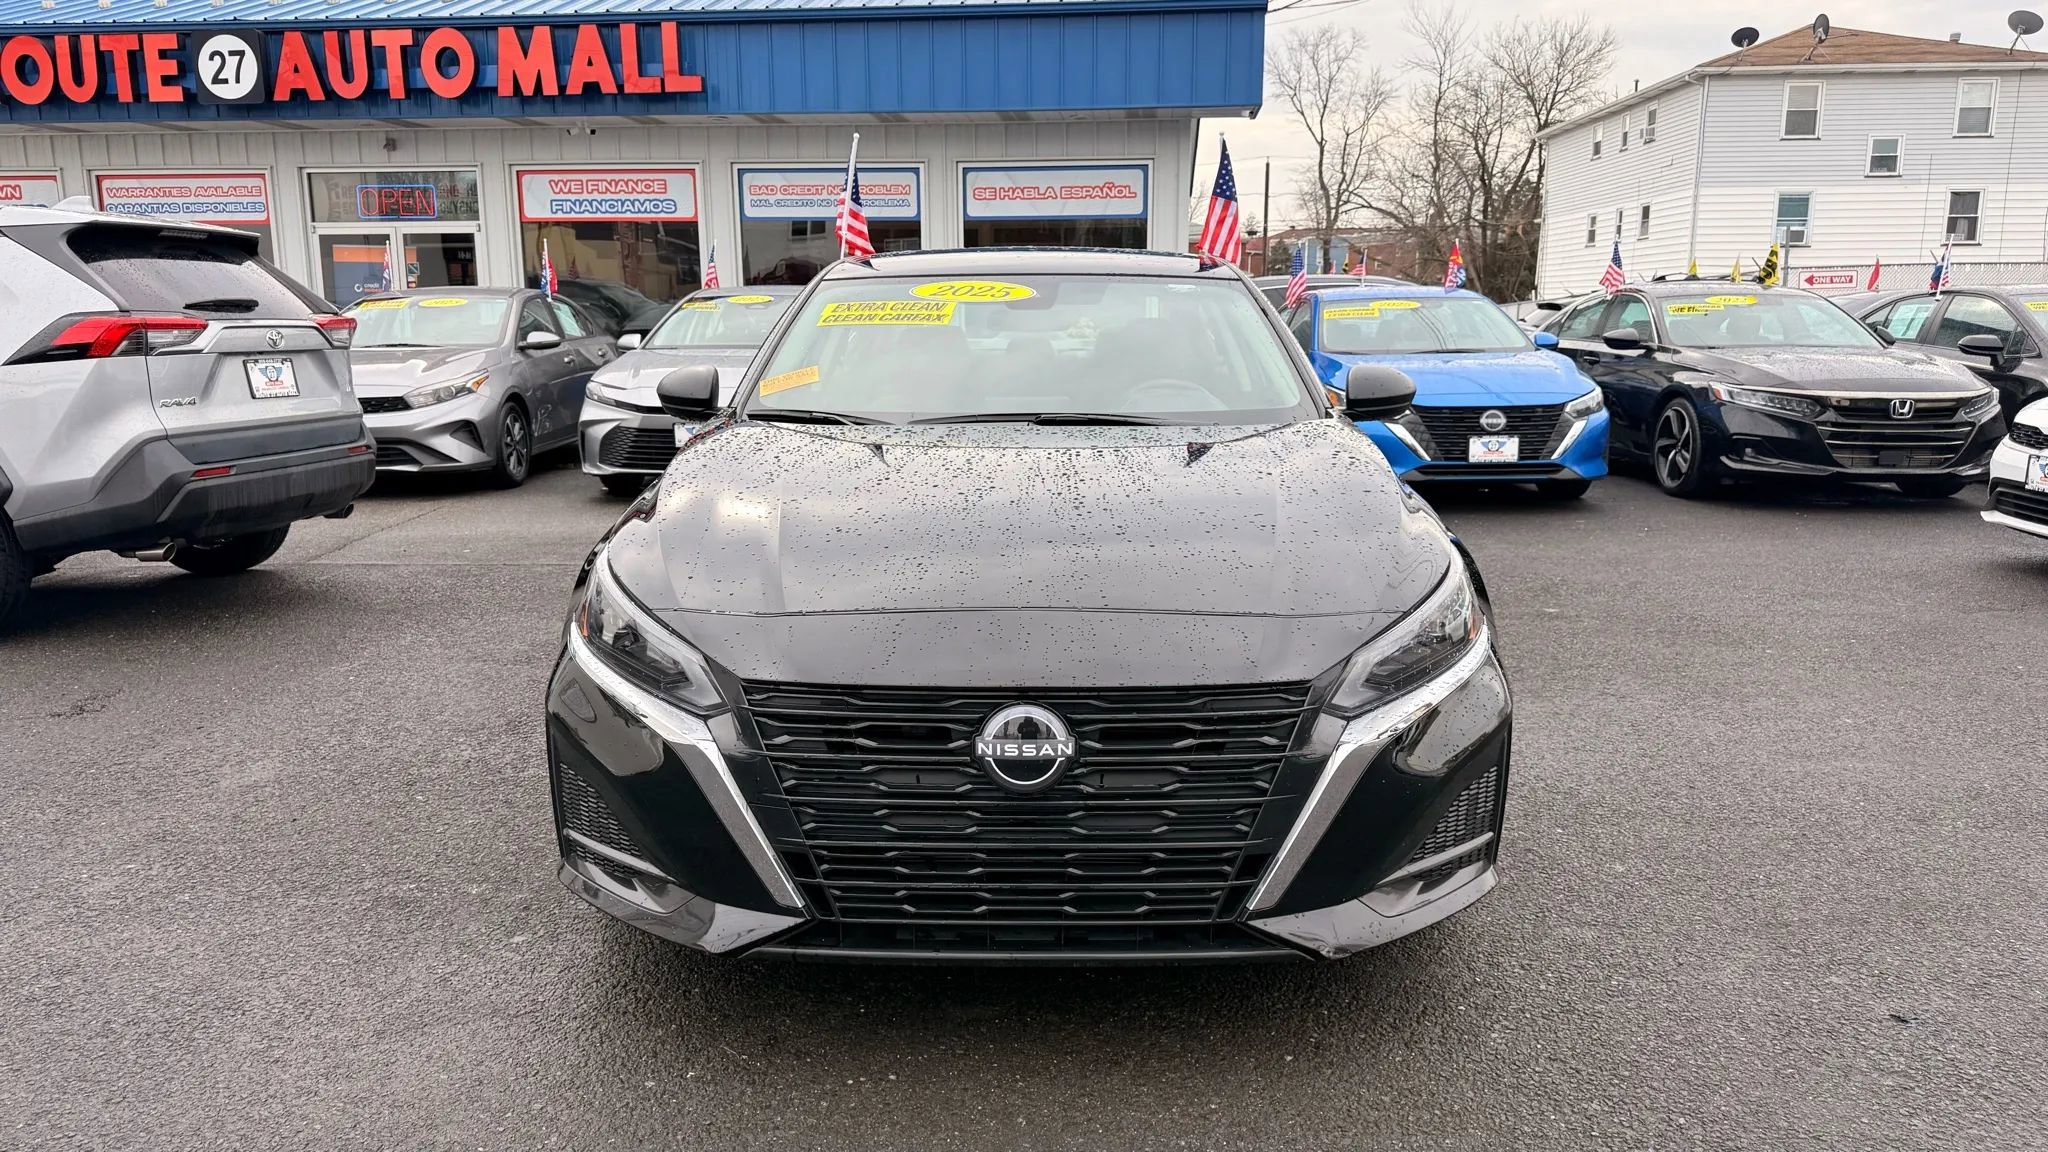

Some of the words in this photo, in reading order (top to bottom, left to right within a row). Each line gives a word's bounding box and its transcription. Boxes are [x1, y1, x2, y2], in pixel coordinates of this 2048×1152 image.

[208, 50, 245, 85] 27
[273, 27, 476, 102] AUTO
[497, 21, 703, 97] MALL
[106, 186, 190, 198] WARRANTIES
[194, 185, 262, 197] AVAILABLE
[550, 179, 584, 194] WE
[586, 179, 667, 195] FINANCE
[750, 185, 777, 196] BAD
[779, 185, 826, 196] CREDIT
[859, 185, 910, 196] ROBLEM
[973, 186, 996, 200] SE
[998, 186, 1057, 200] HABLA
[1060, 181, 1137, 199] ESPAÑOL
[106, 202, 181, 214] GARANTIAS
[182, 202, 265, 214] DISPONIBLES
[360, 187, 435, 216] OPEN
[550, 199, 677, 215] FINANCIAMOS
[750, 199, 773, 208] MAL
[774, 199, 815, 208] CREDITO
[816, 199, 832, 208] NO
[1813, 275, 1832, 285] ONE
[1832, 274, 1851, 284] WAY
[929, 284, 1017, 299] 2025
[830, 302, 887, 313] EXTRA
[888, 301, 947, 312] CLEAN
[822, 313, 878, 324] CLEAN
[878, 312, 950, 323] CARFAX
[977, 742, 1073, 757] NISSAN
